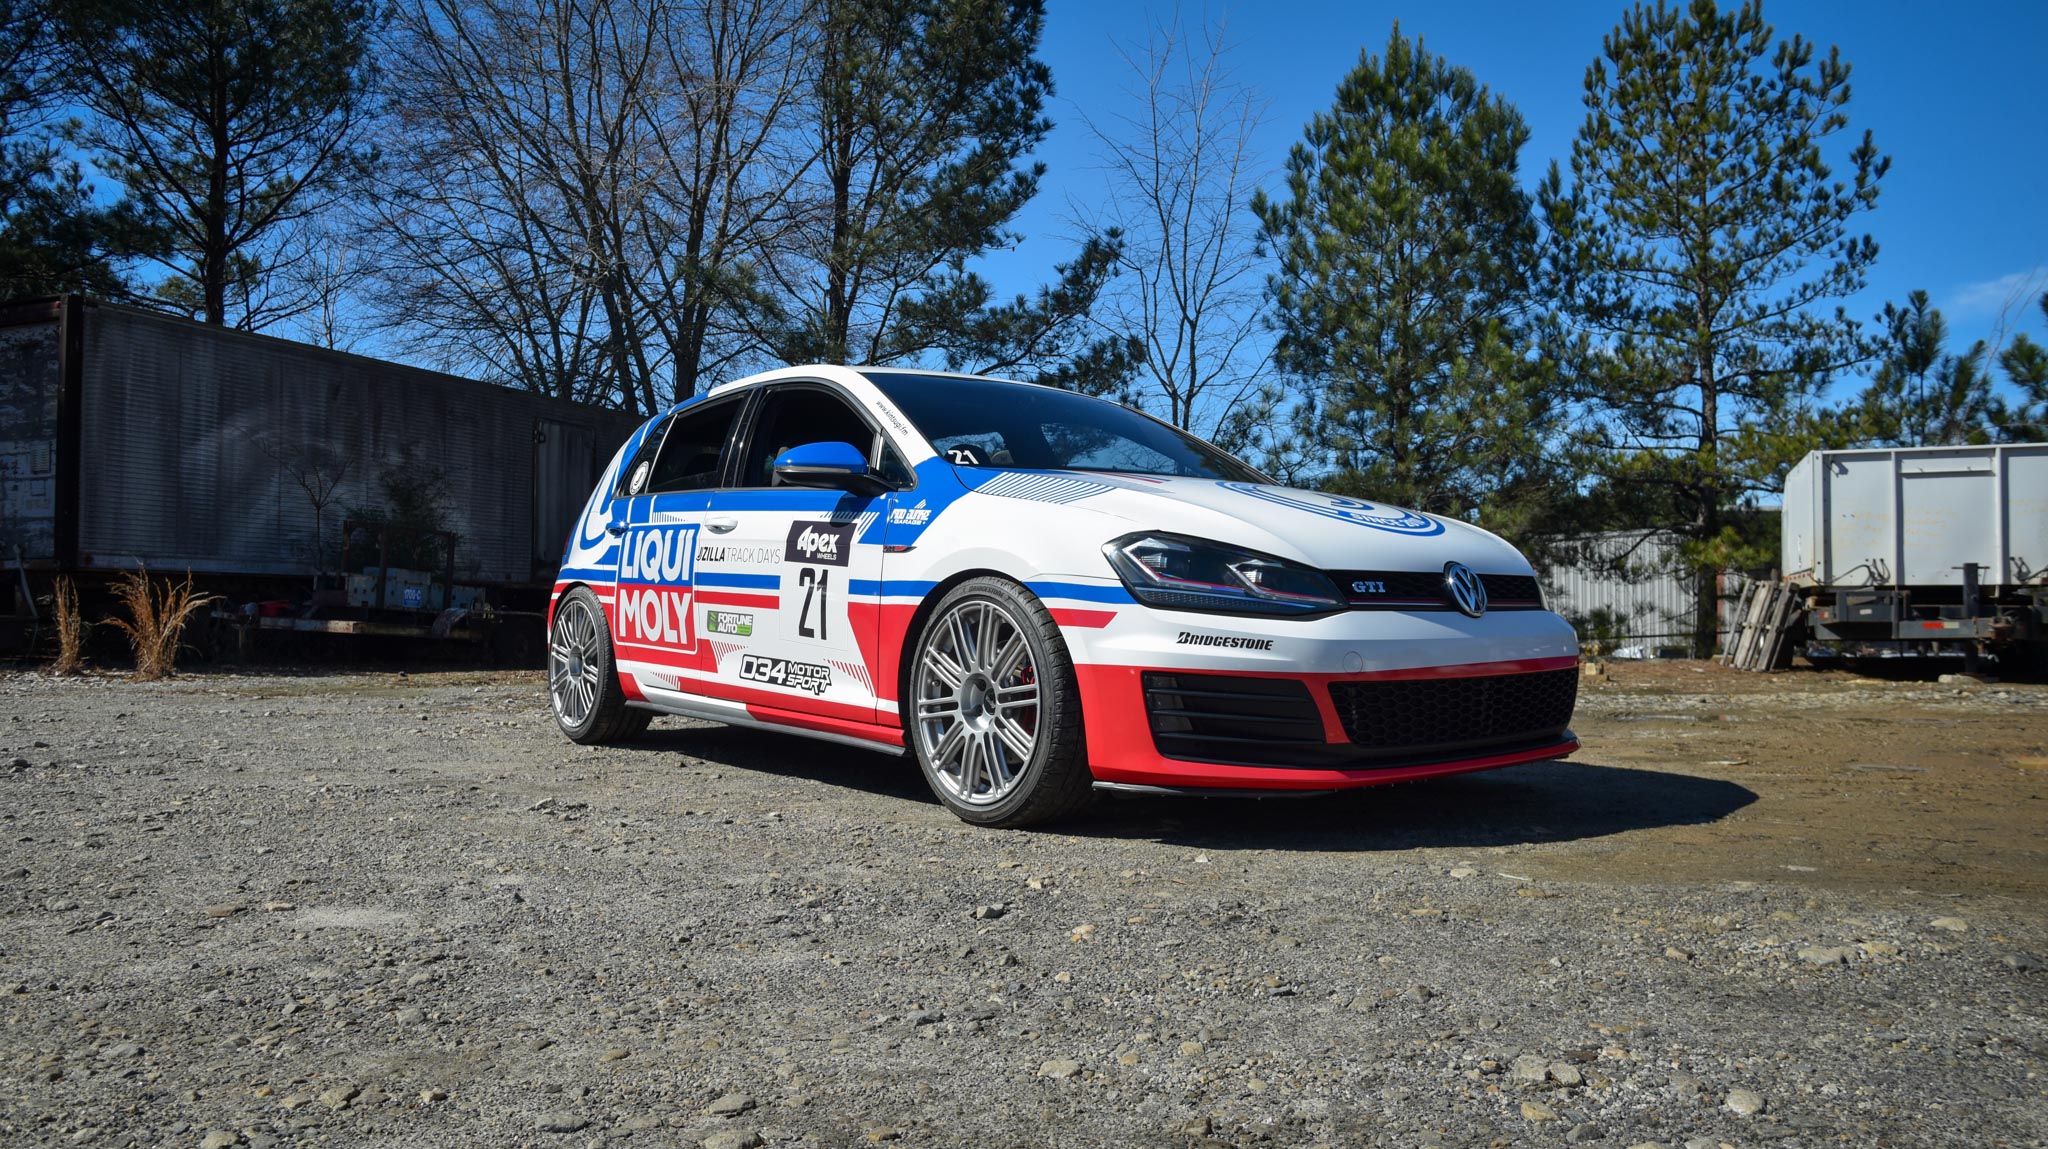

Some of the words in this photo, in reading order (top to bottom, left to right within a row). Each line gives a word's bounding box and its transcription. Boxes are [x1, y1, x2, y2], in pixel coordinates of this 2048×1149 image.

[947, 449, 980, 465] 21
[620, 528, 696, 584] LIQUI
[727, 547, 756, 563] TRACK
[757, 548, 781, 564] DAYS
[816, 552, 837, 561] WHEELS
[1352, 580, 1386, 593] GTI
[798, 567, 829, 641] 21
[619, 589, 692, 645] MOLY
[717, 613, 753, 626] FORTUNE
[717, 623, 738, 634] AUTO
[1176, 631, 1274, 652] BRIDGESTONE
[740, 655, 786, 684] 034
[787, 661, 830, 678] MOTOR
[785, 674, 831, 694] SPORT
